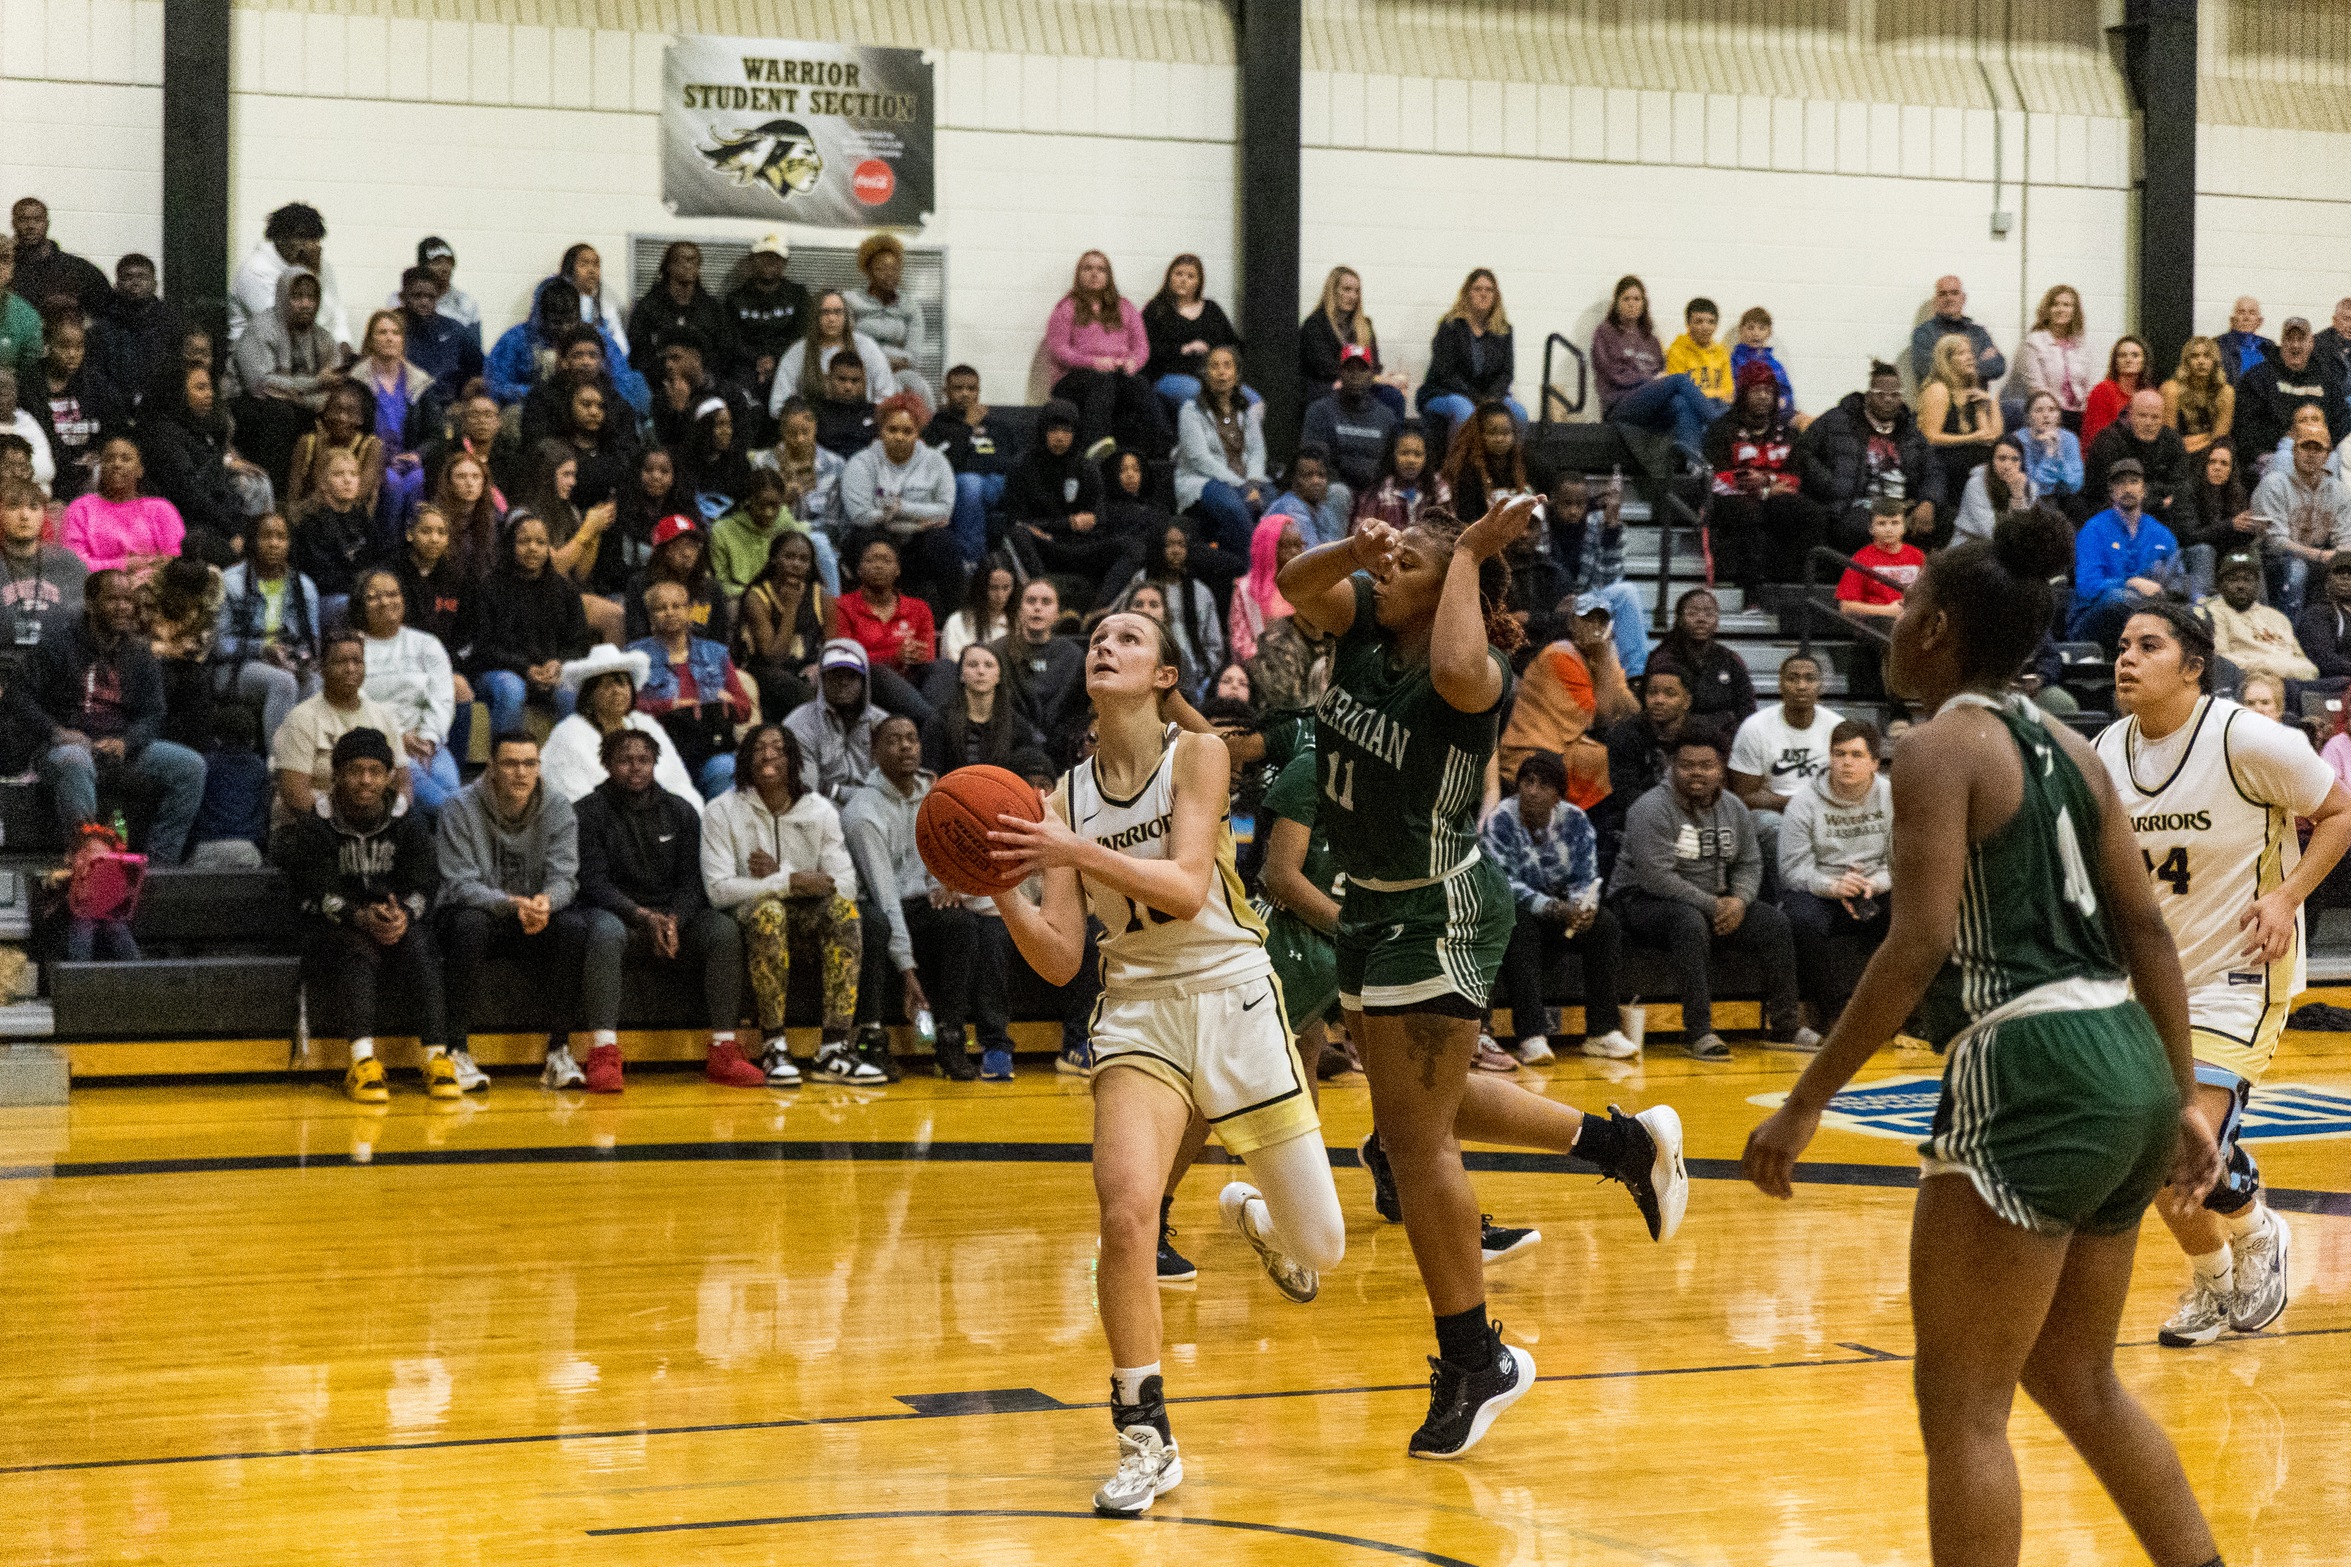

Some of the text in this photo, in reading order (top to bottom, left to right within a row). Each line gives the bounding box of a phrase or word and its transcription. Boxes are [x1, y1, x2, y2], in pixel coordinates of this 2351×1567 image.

[742, 57, 860, 87] WARRIOR
[683, 84, 917, 122] STUDENT SECTION
[1317, 684, 1411, 771] ERIDIAN
[1325, 750, 1354, 812] 11
[1096, 813, 1172, 851] ARRIO
[2130, 810, 2212, 832] RRIORS
